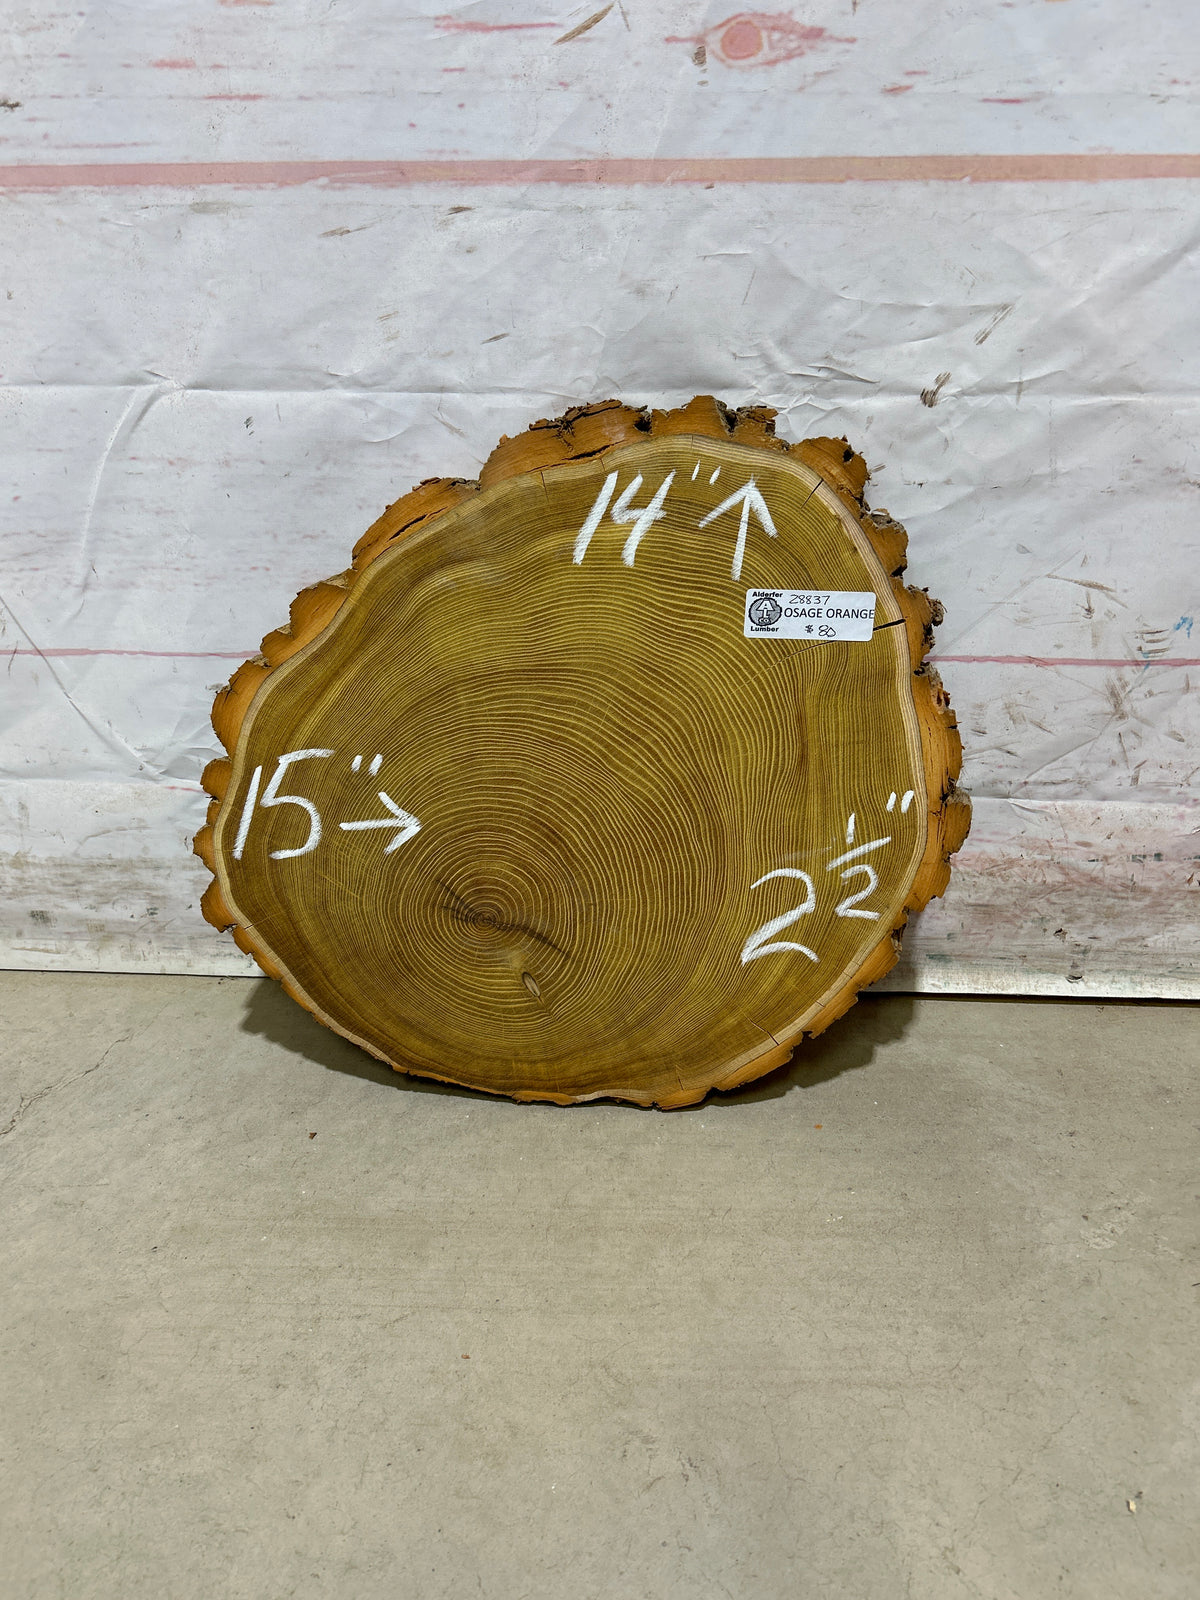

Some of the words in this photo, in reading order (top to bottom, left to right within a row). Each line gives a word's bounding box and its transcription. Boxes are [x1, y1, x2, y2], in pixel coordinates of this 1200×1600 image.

[789, 594, 830, 605] 28837
[784, 608, 823, 618] OSAGE
[826, 609, 875, 619] ORANGE
